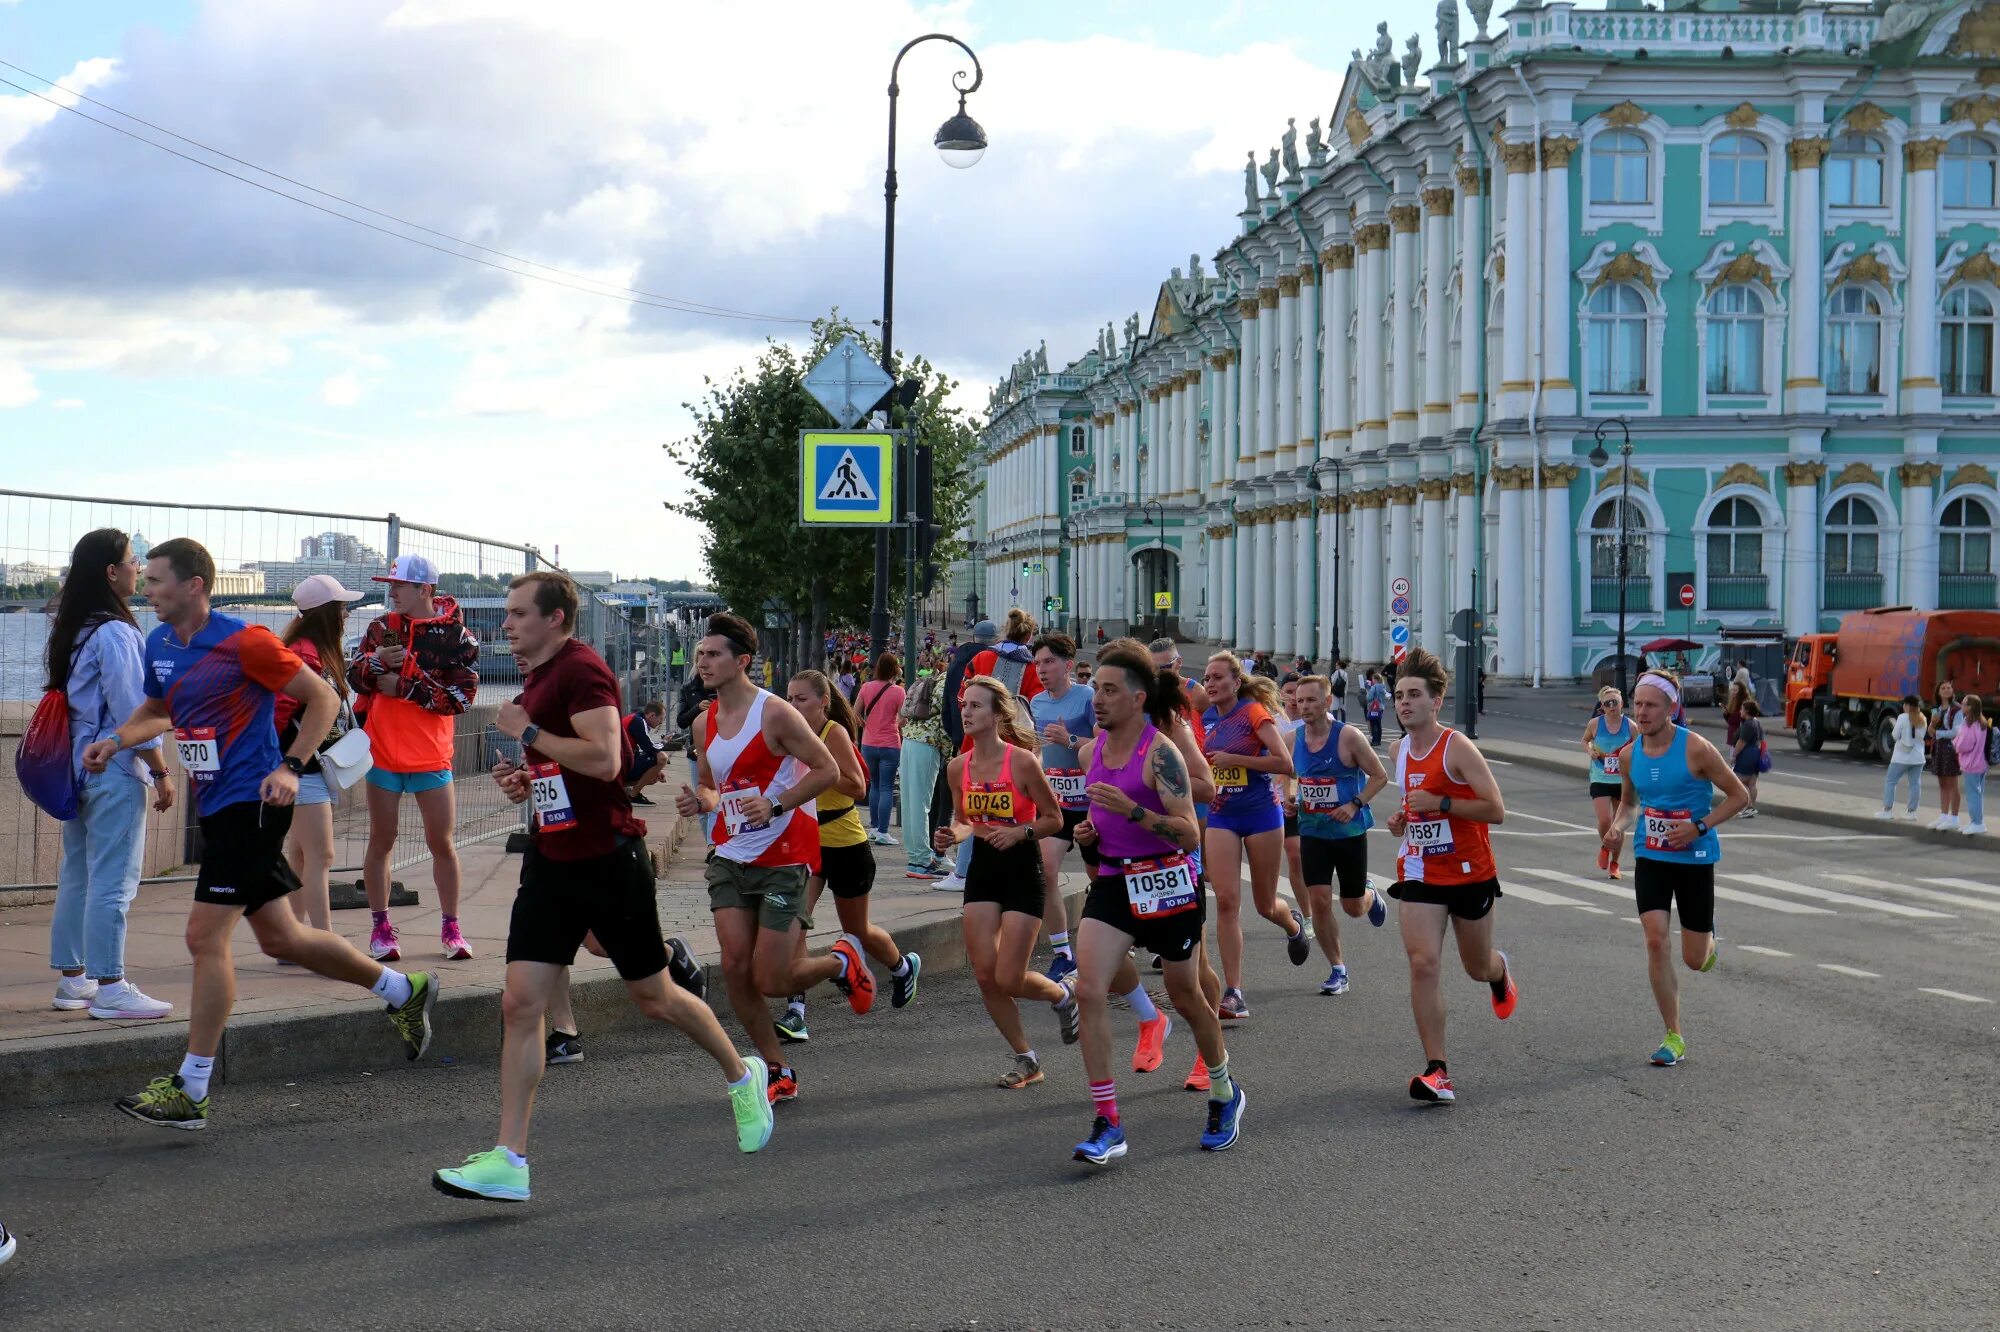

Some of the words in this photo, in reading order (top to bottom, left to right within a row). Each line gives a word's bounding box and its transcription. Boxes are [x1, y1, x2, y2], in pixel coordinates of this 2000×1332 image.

[1212, 767, 1240, 780] 9830
[1050, 778, 1079, 790] 7501
[532, 780, 557, 803] 596
[968, 794, 1010, 810] 10748
[546, 814, 554, 822] 10
[1410, 823, 1442, 839] 9587
[1649, 819, 1668, 832] 86
[1130, 868, 1188, 895] 10581
[1150, 889, 1175, 899] АНДРЕЙ
[1140, 903, 1148, 913] B
[1166, 899, 1176, 907] 10
